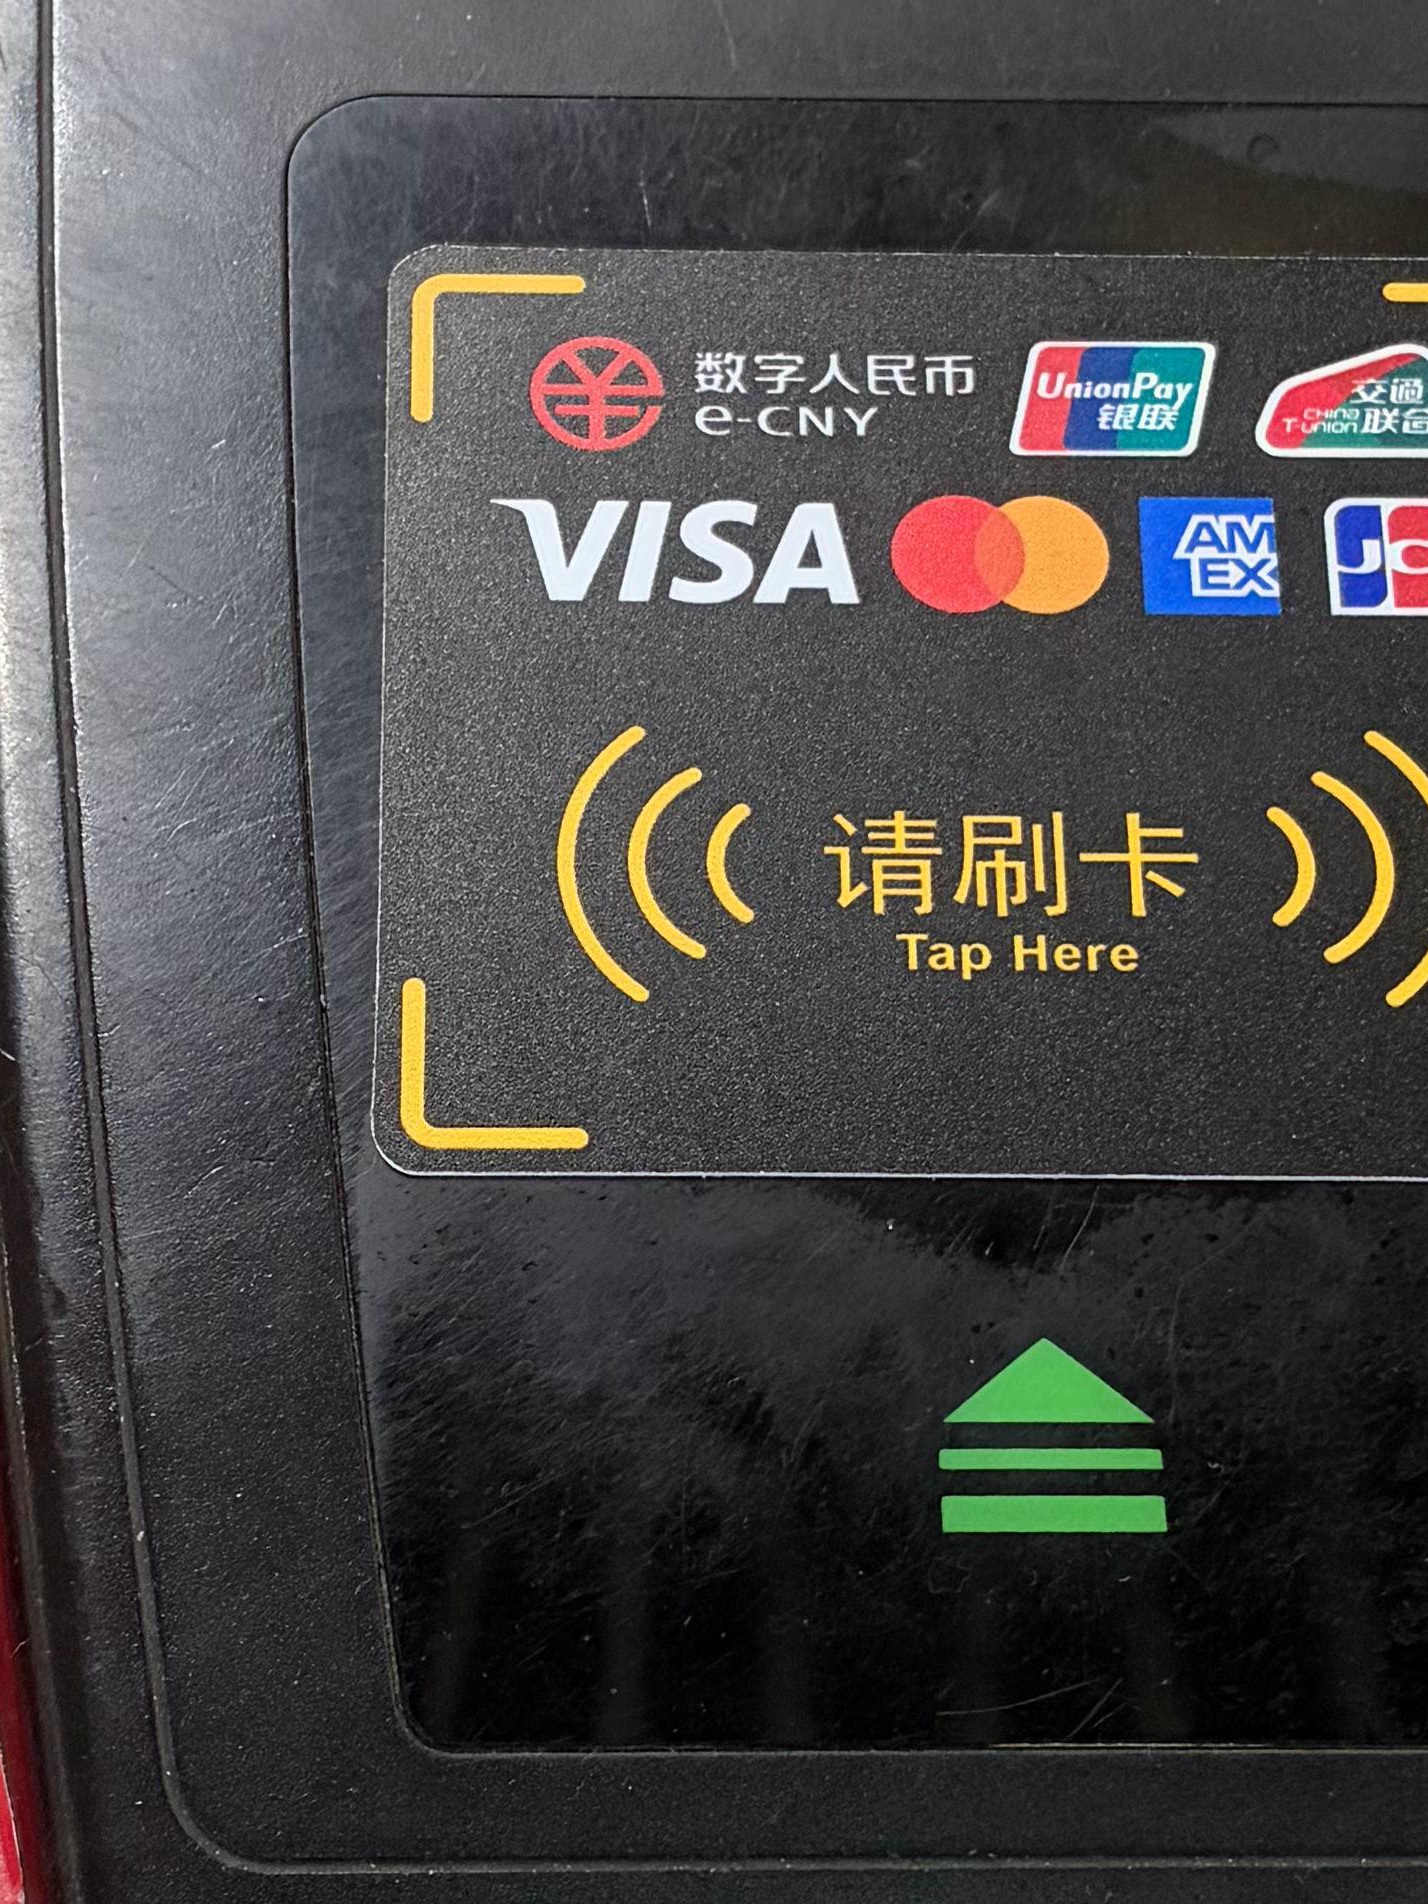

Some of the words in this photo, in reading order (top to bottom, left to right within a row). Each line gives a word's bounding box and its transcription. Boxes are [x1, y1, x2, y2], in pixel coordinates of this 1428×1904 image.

[694, 351, 976, 397] 数字人民币
[1035, 371, 1194, 411] UnionPay
[1349, 377, 1424, 405] 交通
[694, 404, 879, 438] e-CNY
[1097, 402, 1179, 432] 银联
[490, 497, 861, 605] VISA
[824, 808, 1200, 919] 请刷卡
[896, 933, 992, 982] Tap
[1014, 933, 1140, 973] Here
